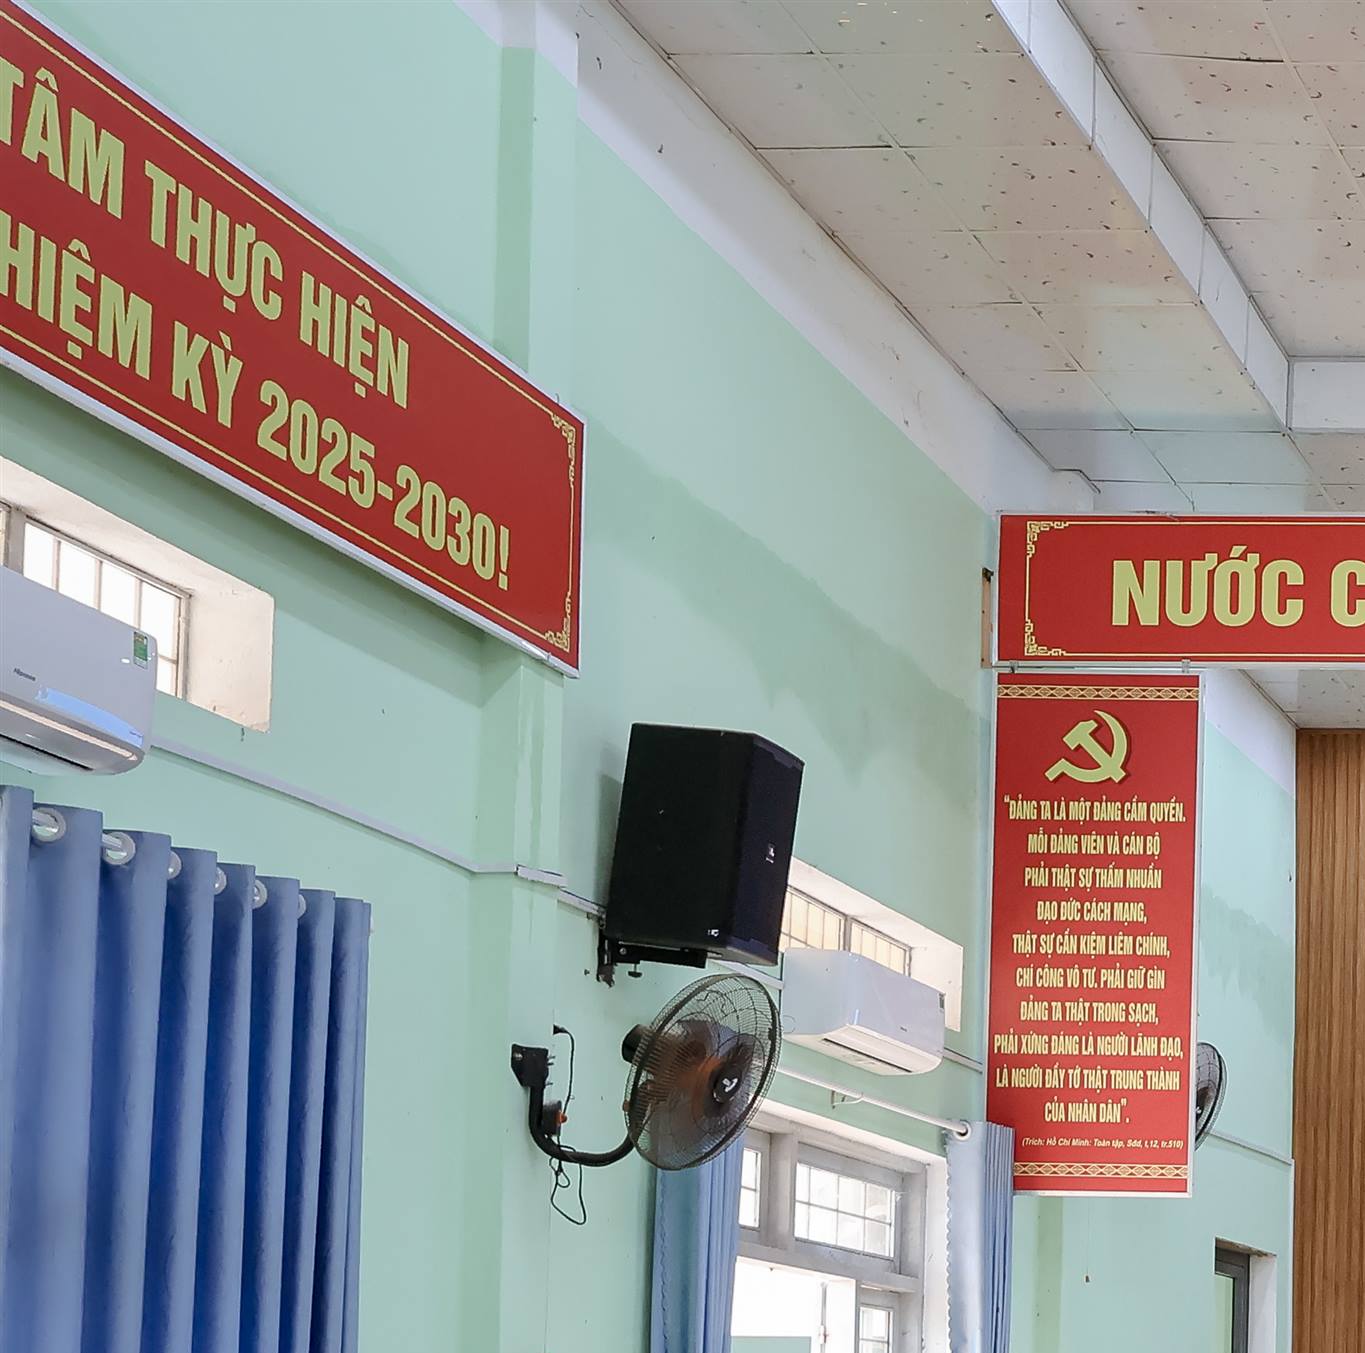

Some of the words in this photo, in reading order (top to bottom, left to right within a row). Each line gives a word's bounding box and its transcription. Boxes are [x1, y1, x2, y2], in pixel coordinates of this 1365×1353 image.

[0, 56, 125, 220] TÂM
[145, 160, 284, 321] THỰC
[300, 271, 409, 409] HIỆN
[172, 320, 243, 428] KỲ
[257, 379, 510, 590] 2025-2030!
[1113, 546, 1303, 626] NƯỚC
[1039, 800, 1052, 821] TA
[1053, 796, 1067, 821] LÀ
[1068, 797, 1092, 824] MỘT
[1093, 795, 1122, 822] ĐẢNG
[1050, 827, 1079, 855] ĐẢNG
[1080, 830, 1105, 855] VIÊN
[1106, 831, 1120, 855] VÀ
[1122, 831, 1144, 855] CÁN
[1146, 831, 1161, 860] BỘ
[1024, 860, 1049, 887] PHẢI
[1051, 863, 1077, 892] THẬT
[1078, 866, 1094, 892] SỰ
[1036, 900, 1058, 925] ĐẠO
[1059, 897, 1082, 921] ĐỨC
[1083, 897, 1112, 922] CÁCH
[1113, 901, 1148, 926] MẠNG,
[1012, 929, 1038, 958] THẬT
[1039, 932, 1055, 958] SỰ
[1079, 931, 1106, 959] KIỆM
[1108, 931, 1134, 955] LIÊM
[1135, 931, 1171, 959] CHÍNH,
[1016, 963, 1034, 988] CHÍ
[1035, 963, 1064, 988] CÔNG
[1066, 964, 1080, 988] VÔ
[1100, 962, 1125, 989] PHẢI
[1146, 965, 1165, 990] GÌN
[1020, 994, 1049, 1021] ĐẢNG
[1050, 1001, 1063, 1022] TA
[1064, 997, 1091, 1026] THẬT
[1092, 1002, 1126, 1023] TRONG
[1128, 1002, 1159, 1027] SẠCH,
[994, 1027, 1018, 1054] PHẢI
[1050, 1031, 1080, 1056] ĐÁNG
[1081, 1031, 1095, 1056] LÀ
[1096, 1031, 1129, 1056] NGƯỜI
[1130, 1032, 1158, 1057] LÃNH
[1159, 1036, 1184, 1061] ĐẠO,
[996, 1063, 1009, 1088] LÀ
[1011, 1063, 1043, 1088] NGƯỜI
[1082, 1065, 1109, 1094] THẬT
[1109, 1069, 1144, 1090] TRUNG
[1145, 1066, 1180, 1091] THÀNH
[1044, 1095, 1066, 1122] CỦA
[1067, 1098, 1097, 1123] NHÂN
